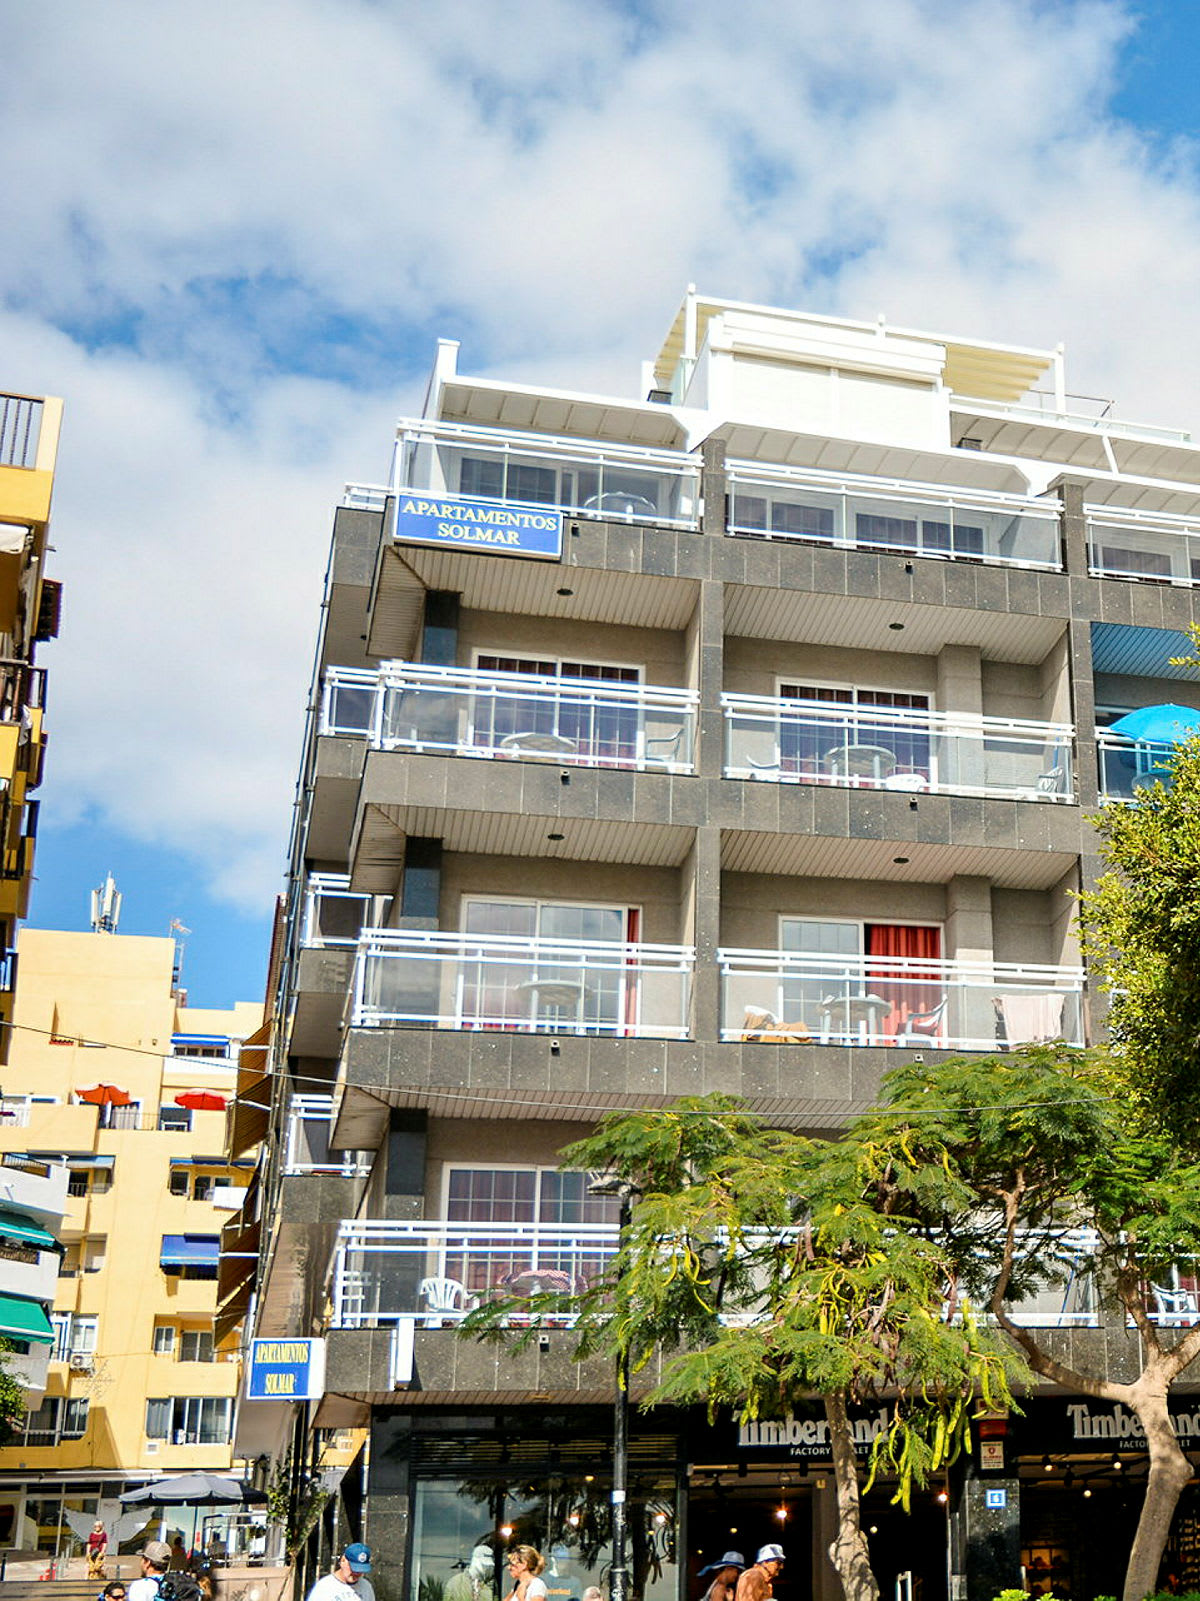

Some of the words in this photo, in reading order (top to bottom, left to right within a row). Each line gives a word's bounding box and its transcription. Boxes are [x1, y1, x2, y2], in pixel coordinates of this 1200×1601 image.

[402, 500, 557, 532] APARTAMENTOS
[437, 522, 520, 546] SOLMAR
[254, 1342, 309, 1364] APARTAMENTOS
[264, 1373, 295, 1395] SOLMAR
[790, 1447, 831, 1456] FACTORY
[1119, 1440, 1149, 1449] FACTO
